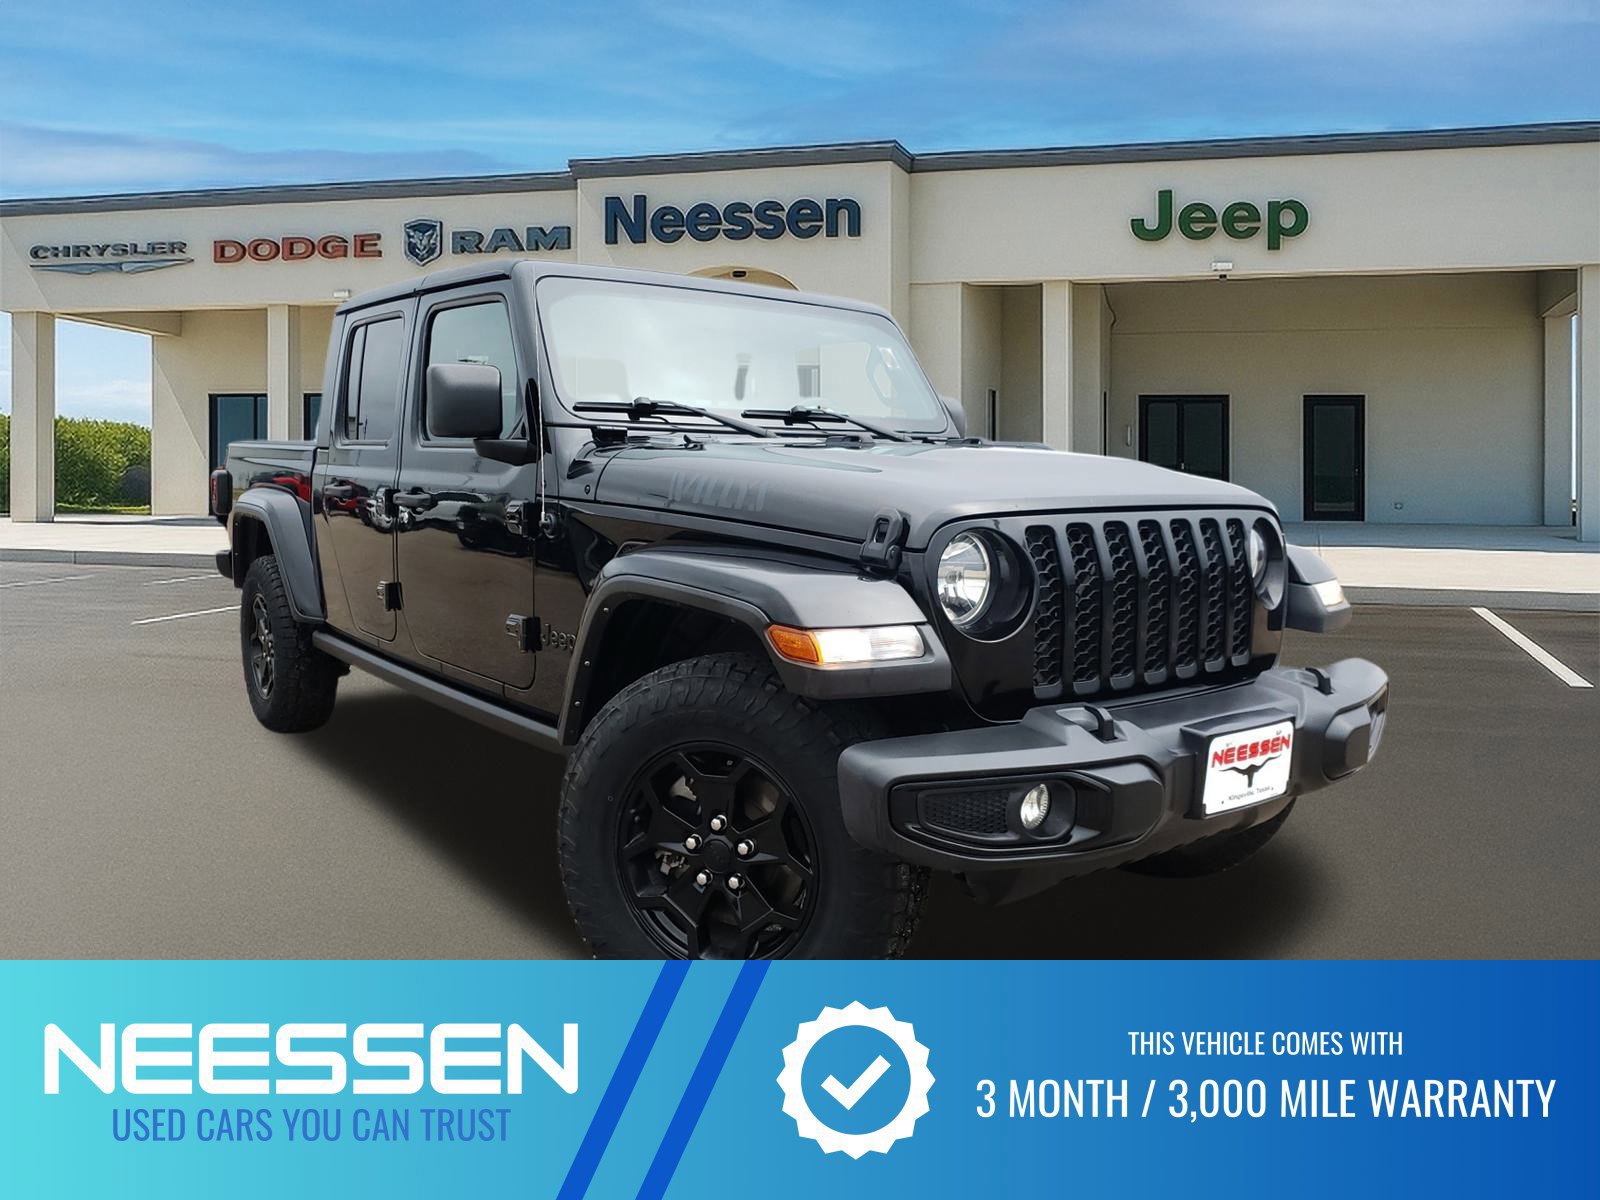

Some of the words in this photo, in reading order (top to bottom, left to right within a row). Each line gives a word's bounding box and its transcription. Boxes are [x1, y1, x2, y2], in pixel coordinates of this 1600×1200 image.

[604, 194, 862, 245] Neessen
[1130, 190, 1310, 250] Jeep
[29, 241, 188, 261] CHRYSLER
[213, 233, 382, 264] DODGE
[451, 226, 571, 255] RAM
[541, 623, 576, 652] Jeep
[1211, 734, 1291, 768] NEESSEN
